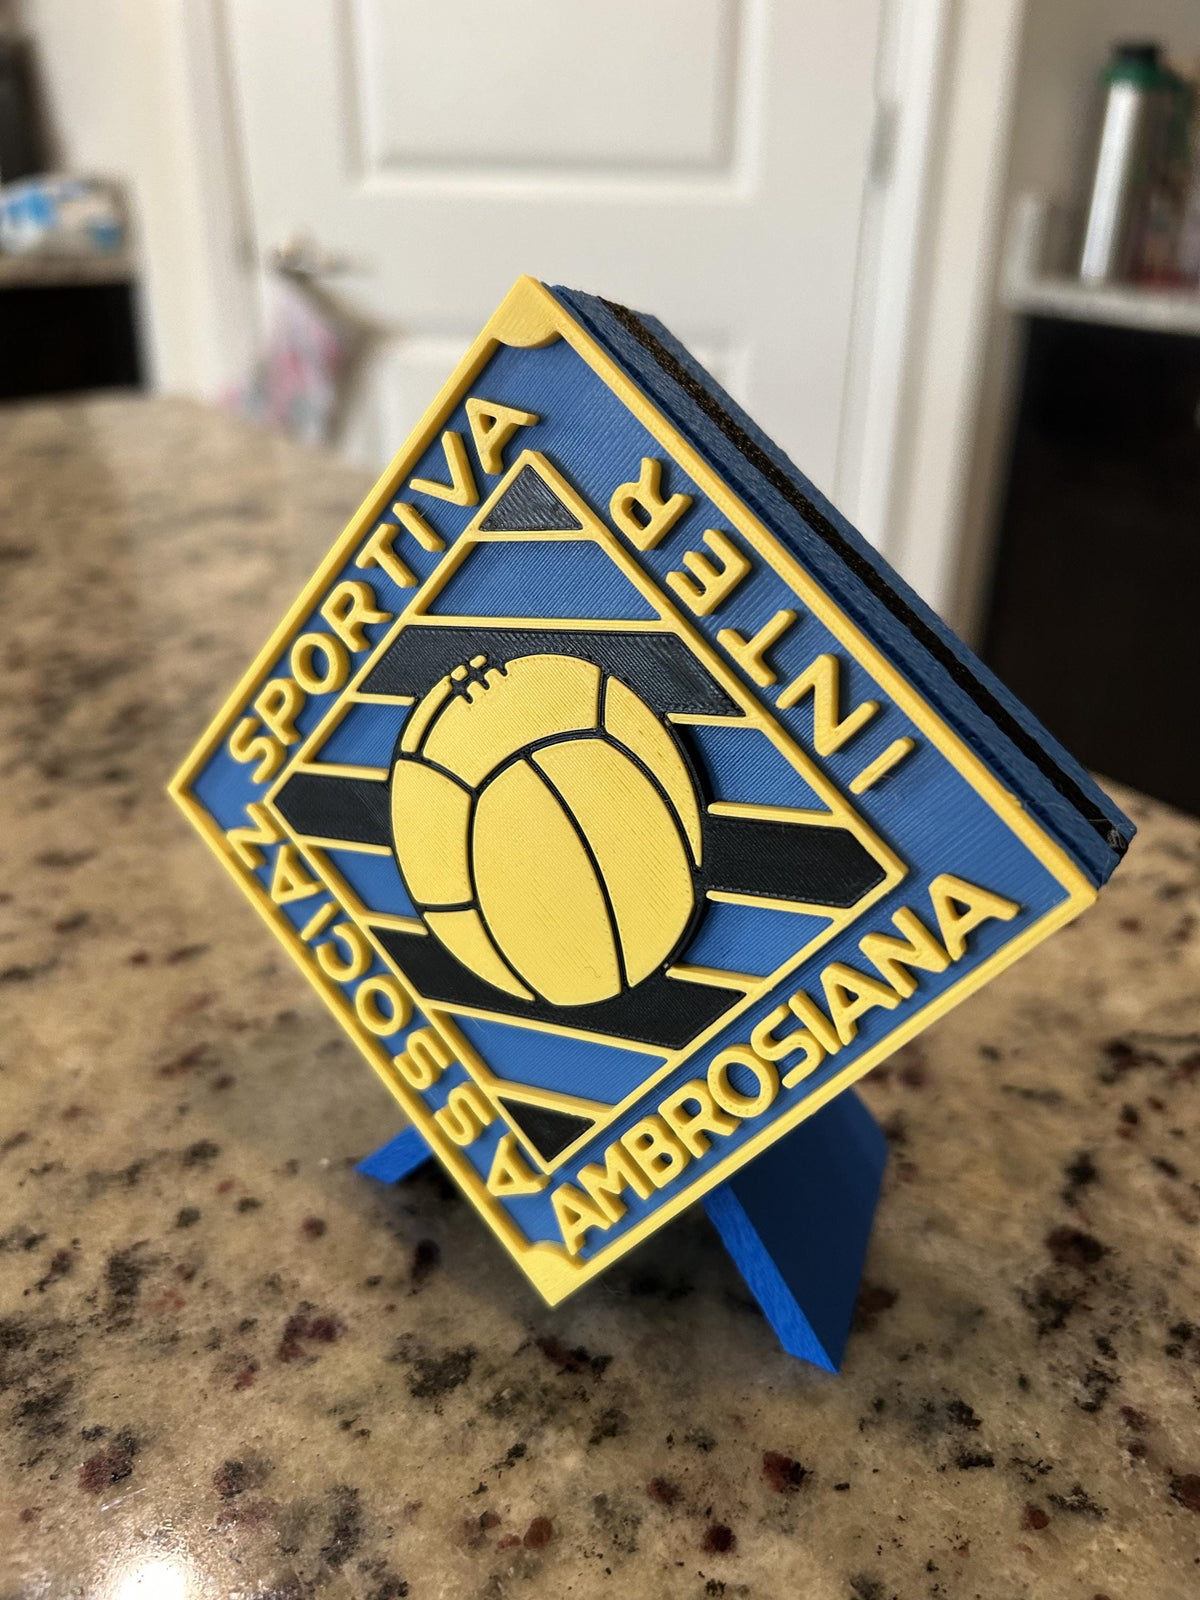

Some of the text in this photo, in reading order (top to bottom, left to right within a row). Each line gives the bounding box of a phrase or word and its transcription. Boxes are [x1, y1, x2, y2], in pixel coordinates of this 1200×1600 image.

[229, 398, 540, 784] SPORTIVA
[609, 457, 915, 794] INTER
[227, 804, 549, 1196] ASSOCIAZ
[550, 873, 1022, 1256] AMBROSIANA
